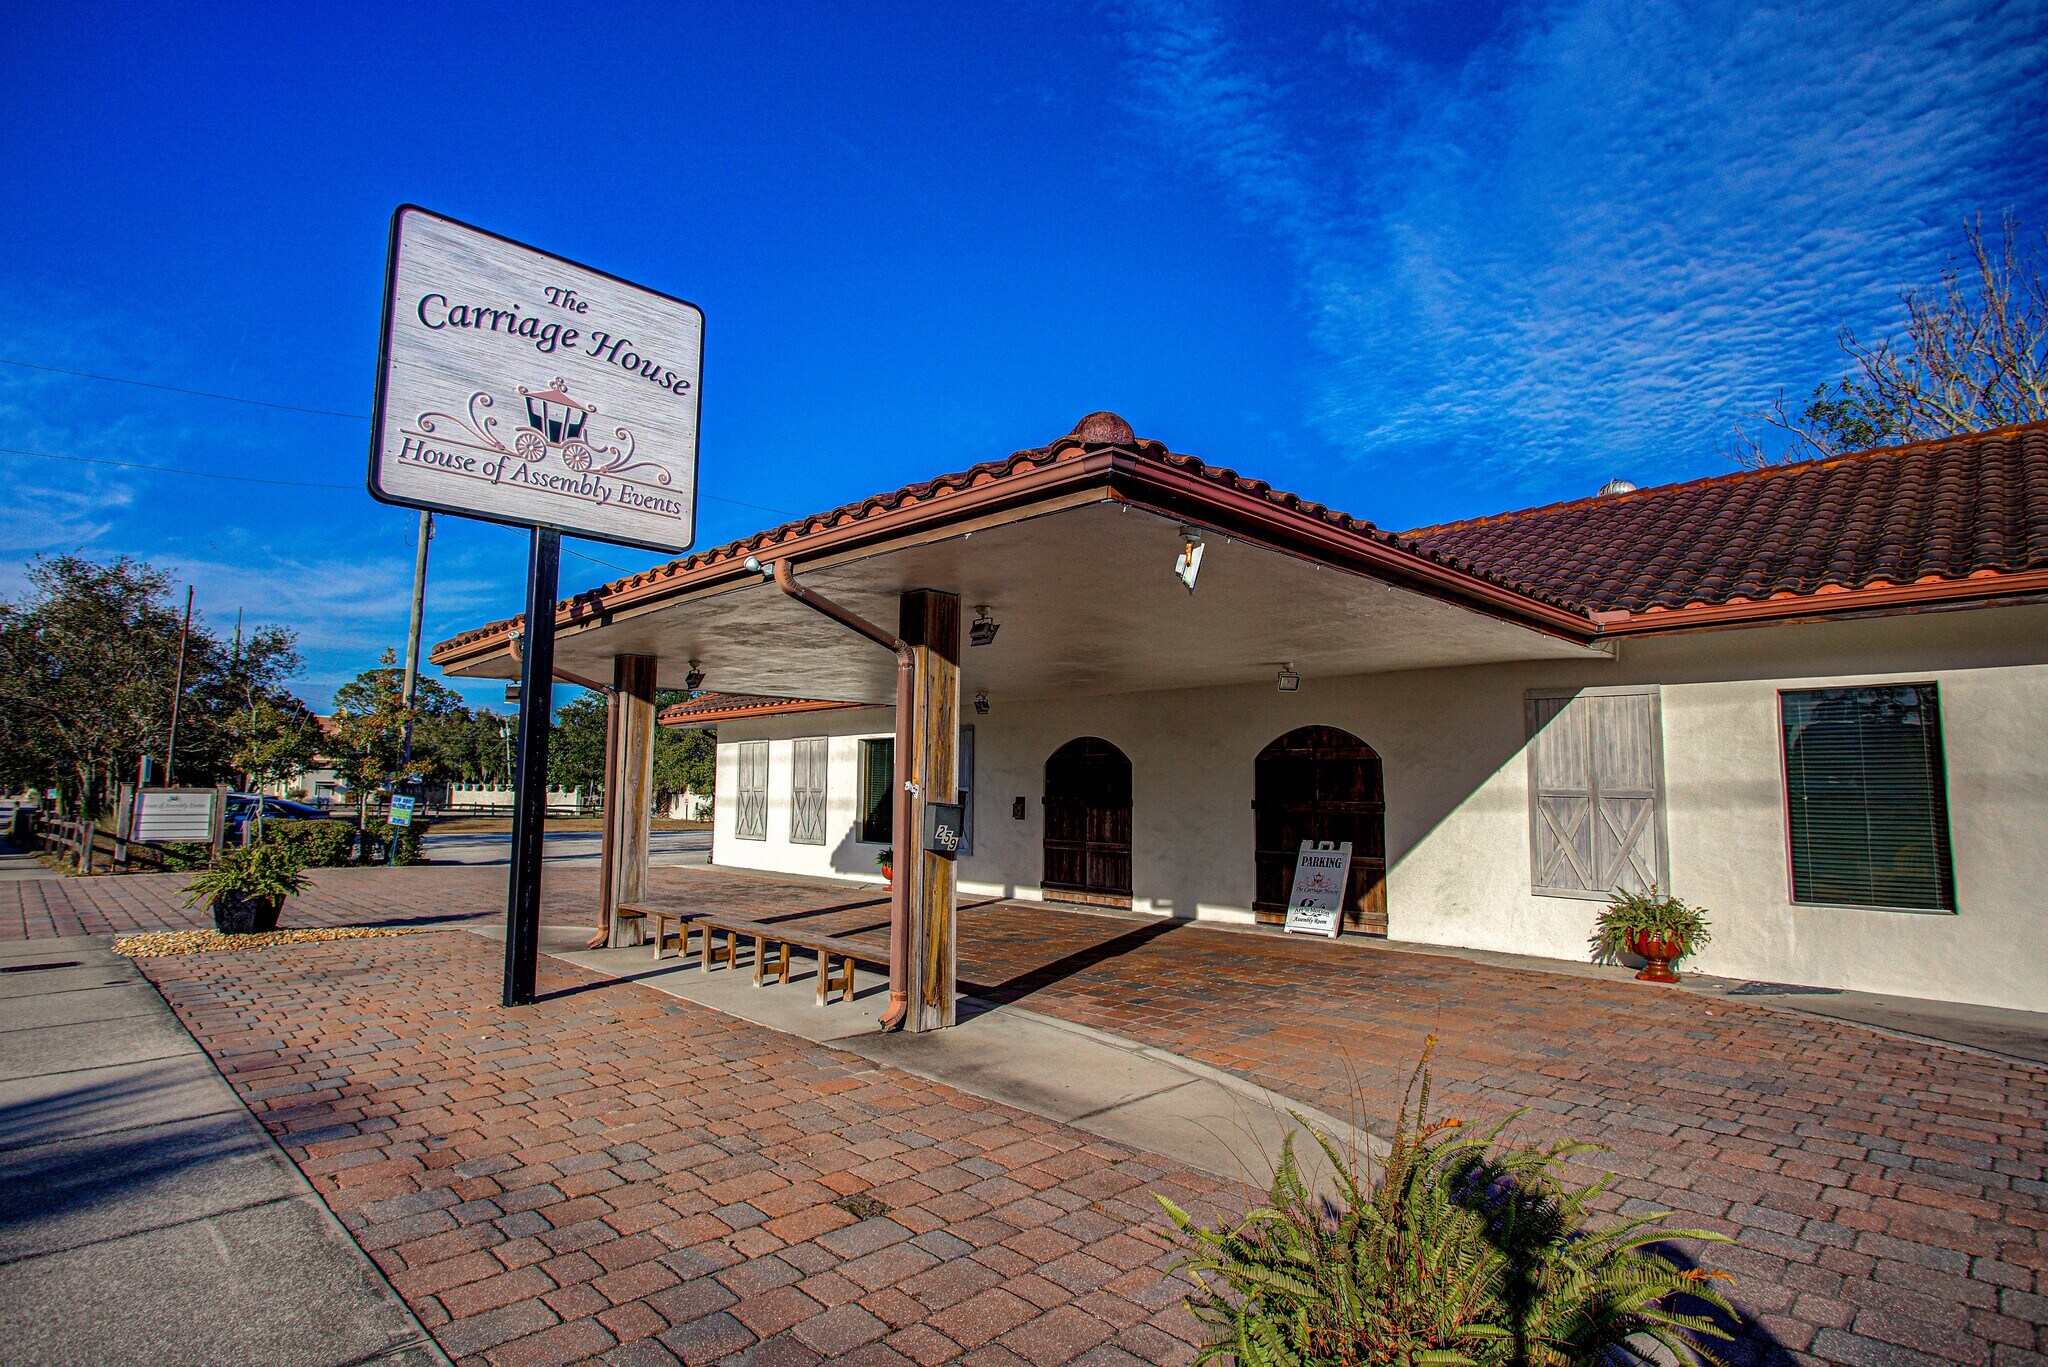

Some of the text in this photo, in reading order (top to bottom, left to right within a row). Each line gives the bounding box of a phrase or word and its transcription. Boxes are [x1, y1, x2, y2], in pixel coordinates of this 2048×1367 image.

[544, 286, 589, 314] The
[417, 293, 691, 396] Carriage House
[398, 436, 682, 515] House of Assembly Events
[936, 826, 957, 850] 259
[1302, 856, 1342, 869] PARKING
[1304, 886, 1322, 894] Carriage
[1293, 916, 1313, 924] Assembly
